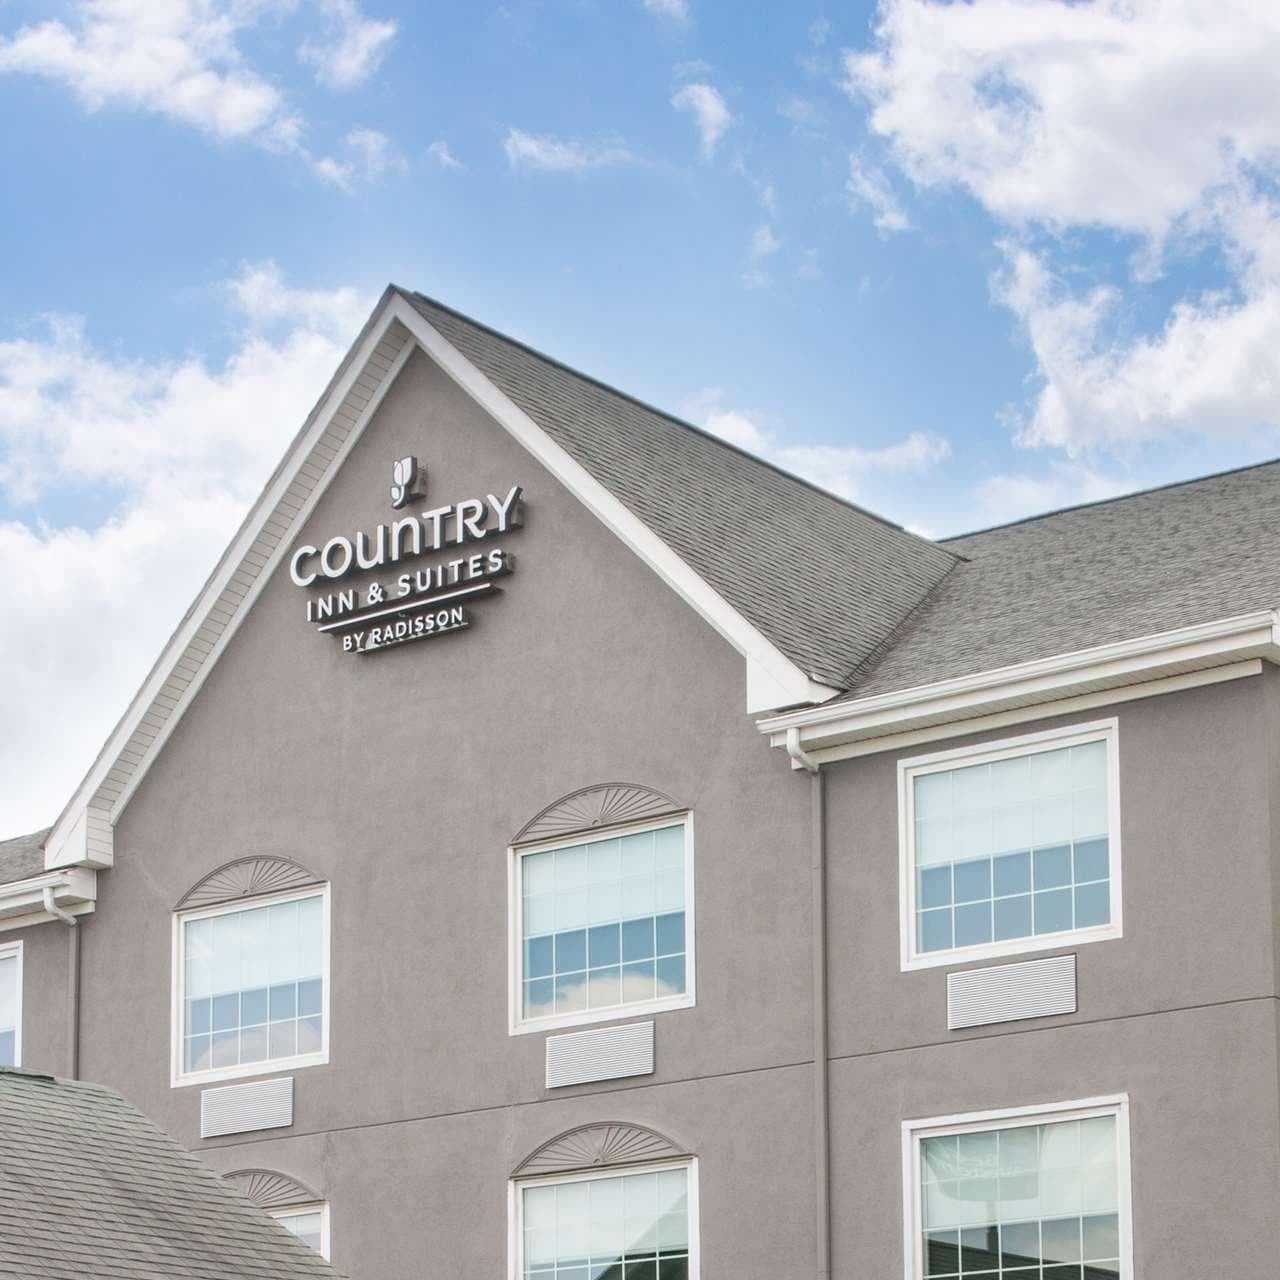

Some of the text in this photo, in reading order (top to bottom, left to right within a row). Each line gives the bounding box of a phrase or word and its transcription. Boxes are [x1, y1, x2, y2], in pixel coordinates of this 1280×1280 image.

[306, 549, 504, 622] INN & SUITES
[343, 606, 464, 651] BY RADISSON
